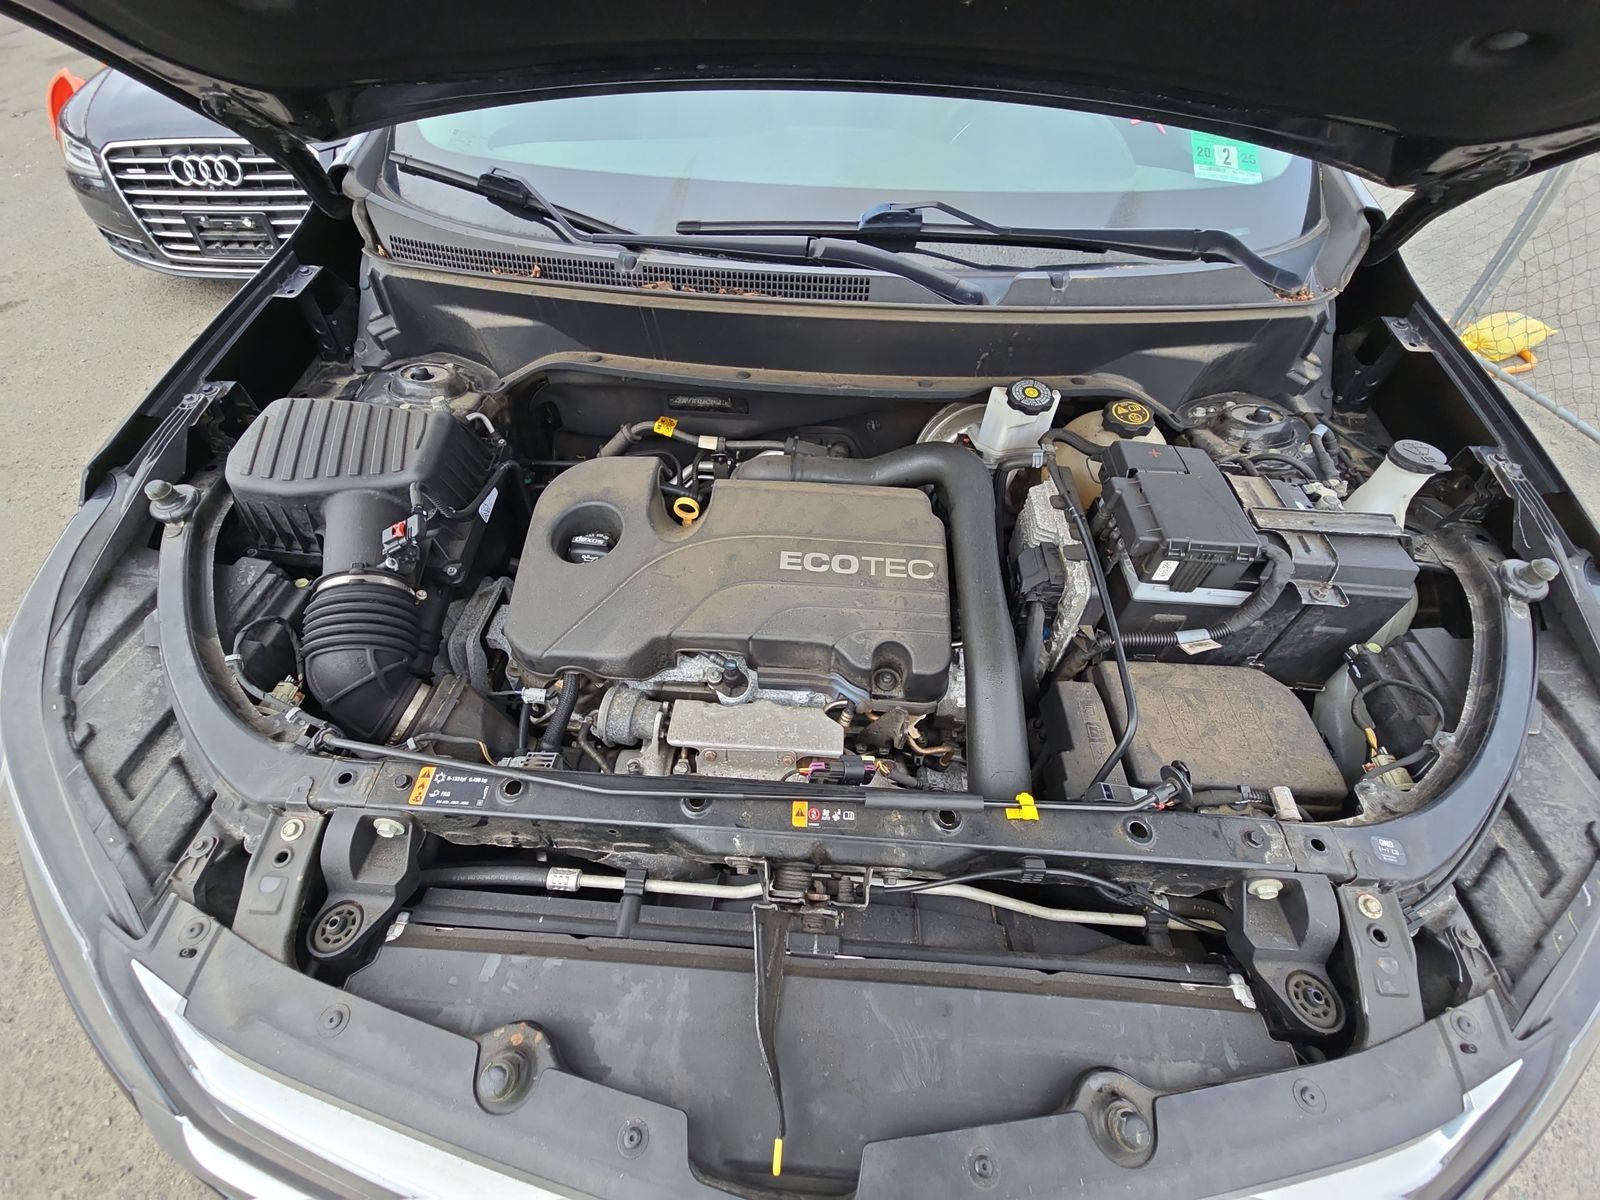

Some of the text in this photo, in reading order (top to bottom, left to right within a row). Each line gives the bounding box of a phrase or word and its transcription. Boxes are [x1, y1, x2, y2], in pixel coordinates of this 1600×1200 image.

[1196, 146, 1257, 166] 20 2 25
[779, 551, 935, 580] ECOTEC
